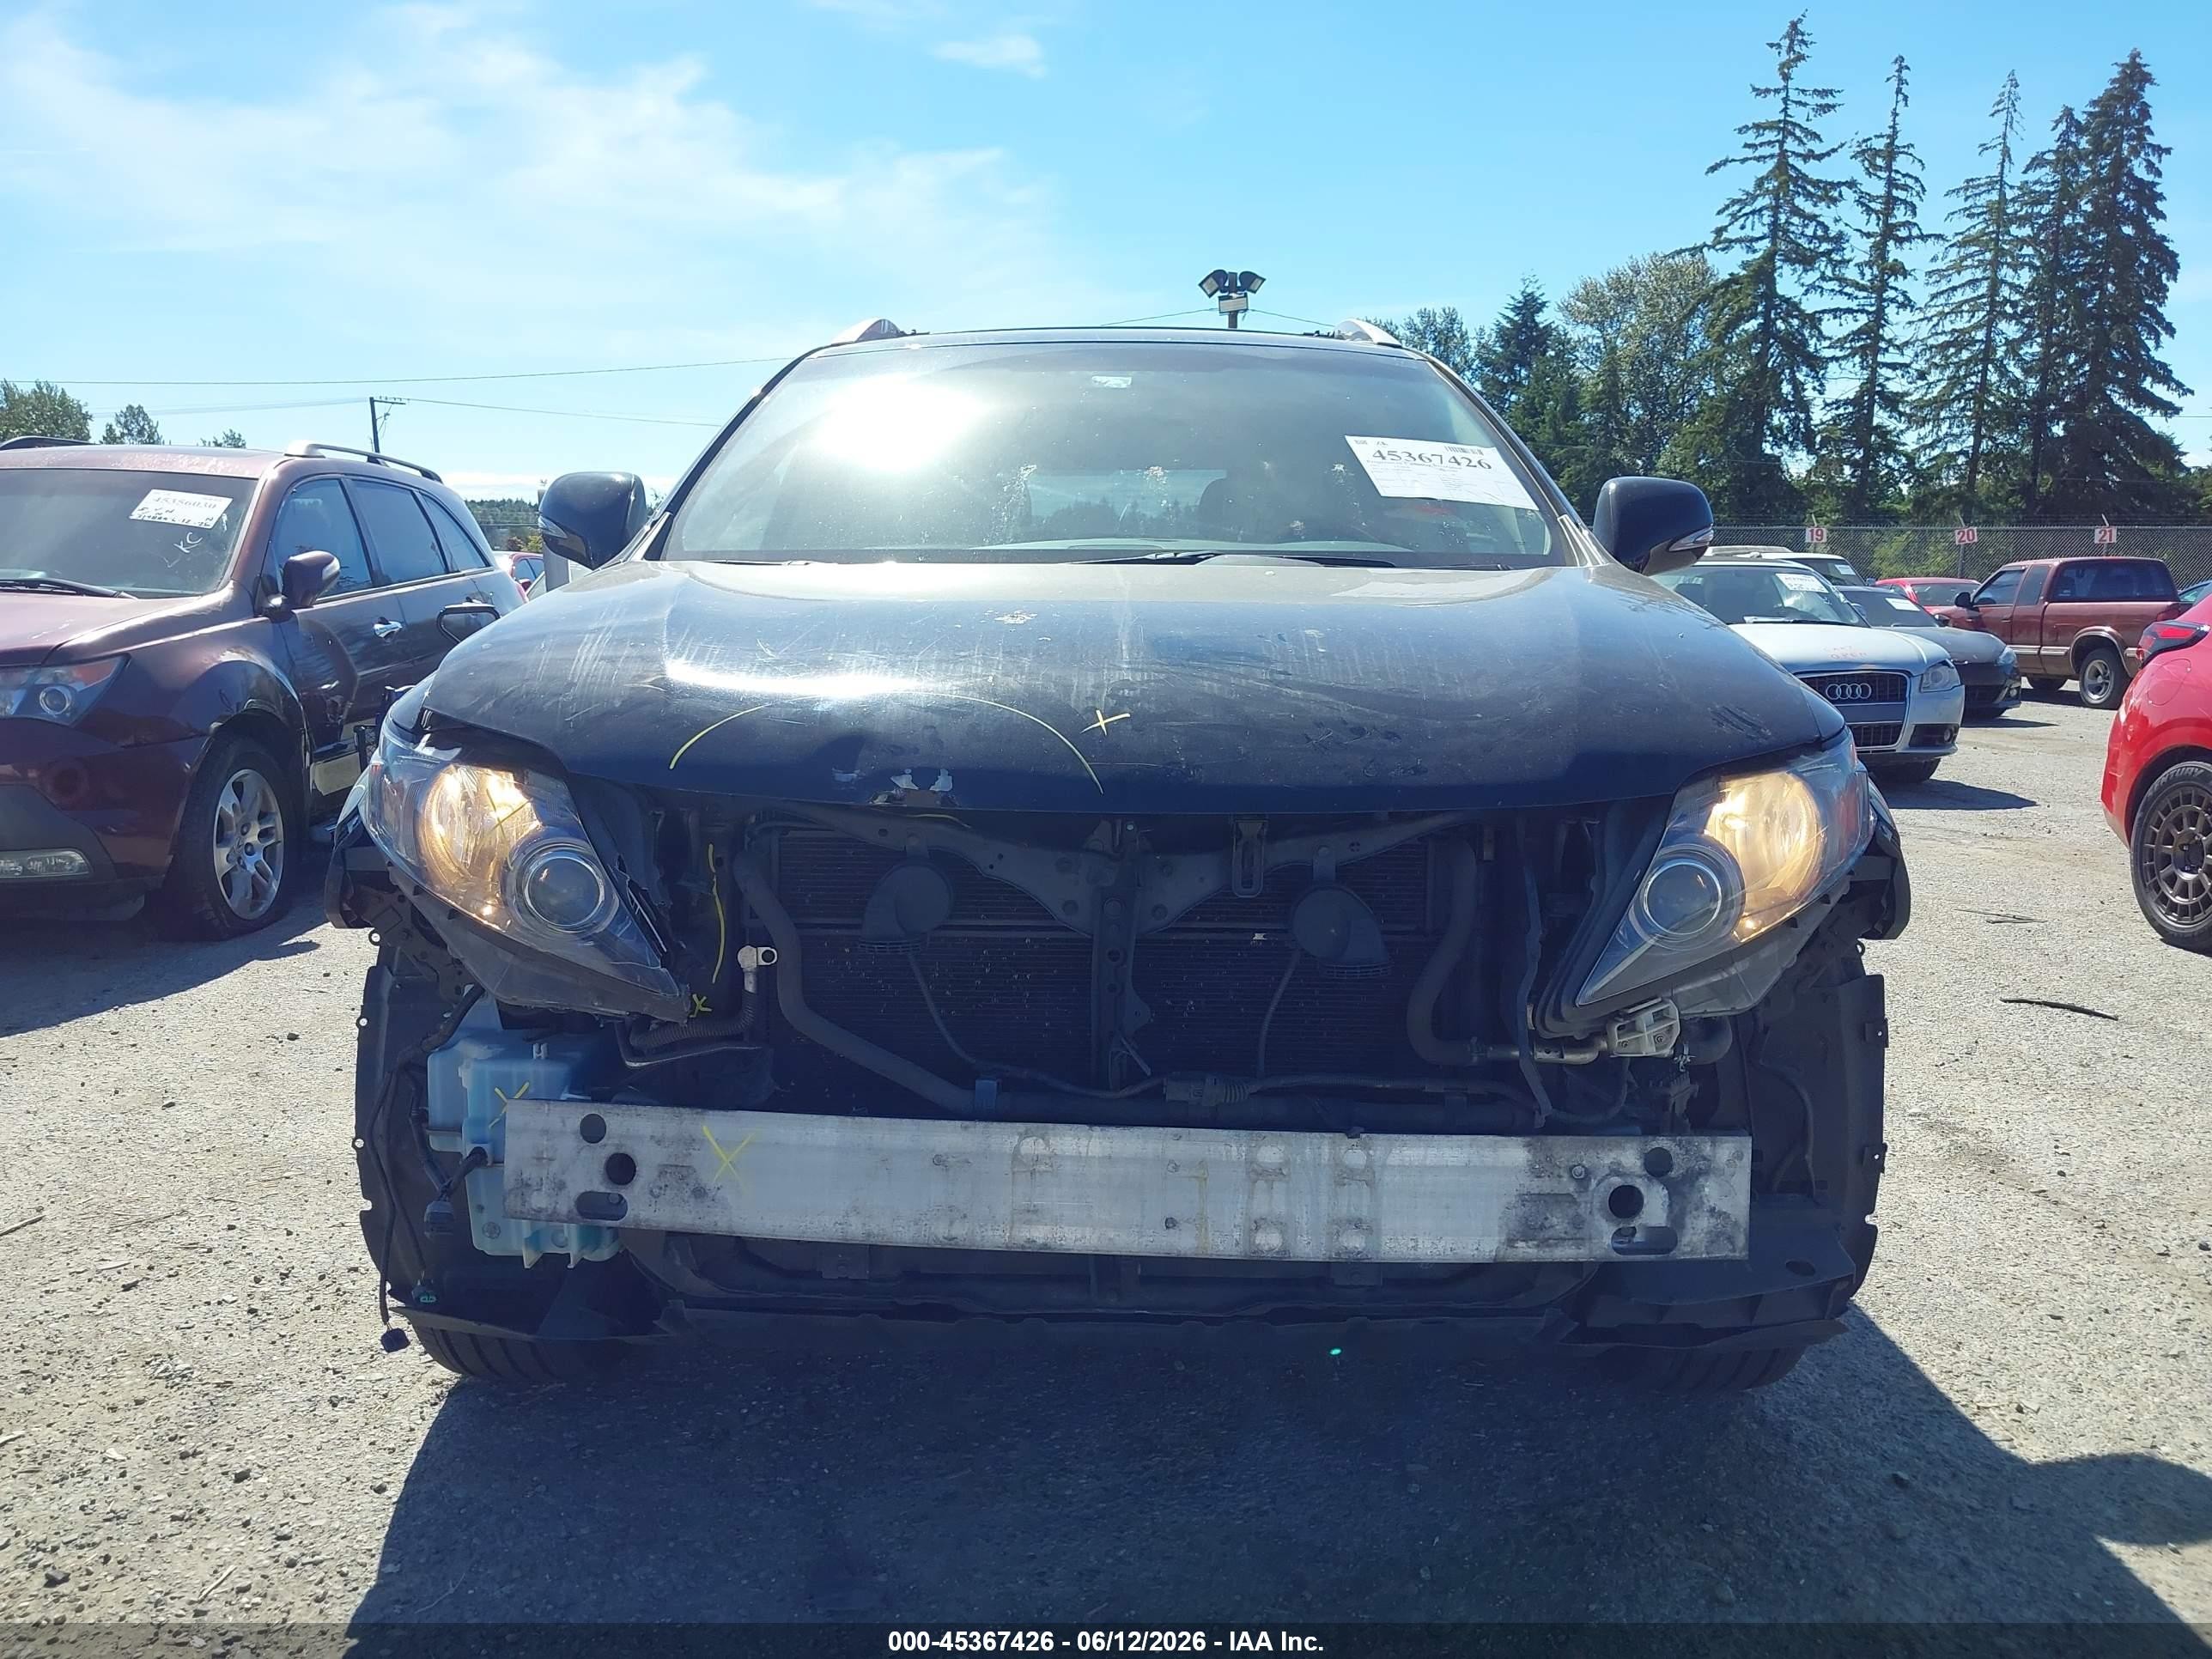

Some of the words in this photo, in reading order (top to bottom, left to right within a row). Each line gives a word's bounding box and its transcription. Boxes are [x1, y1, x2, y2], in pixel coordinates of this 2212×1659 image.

[1372, 448, 1492, 471] 45367426
[1809, 528, 1824, 542] 19
[1957, 528, 1976, 544] 20
[2098, 528, 2113, 543] 21
